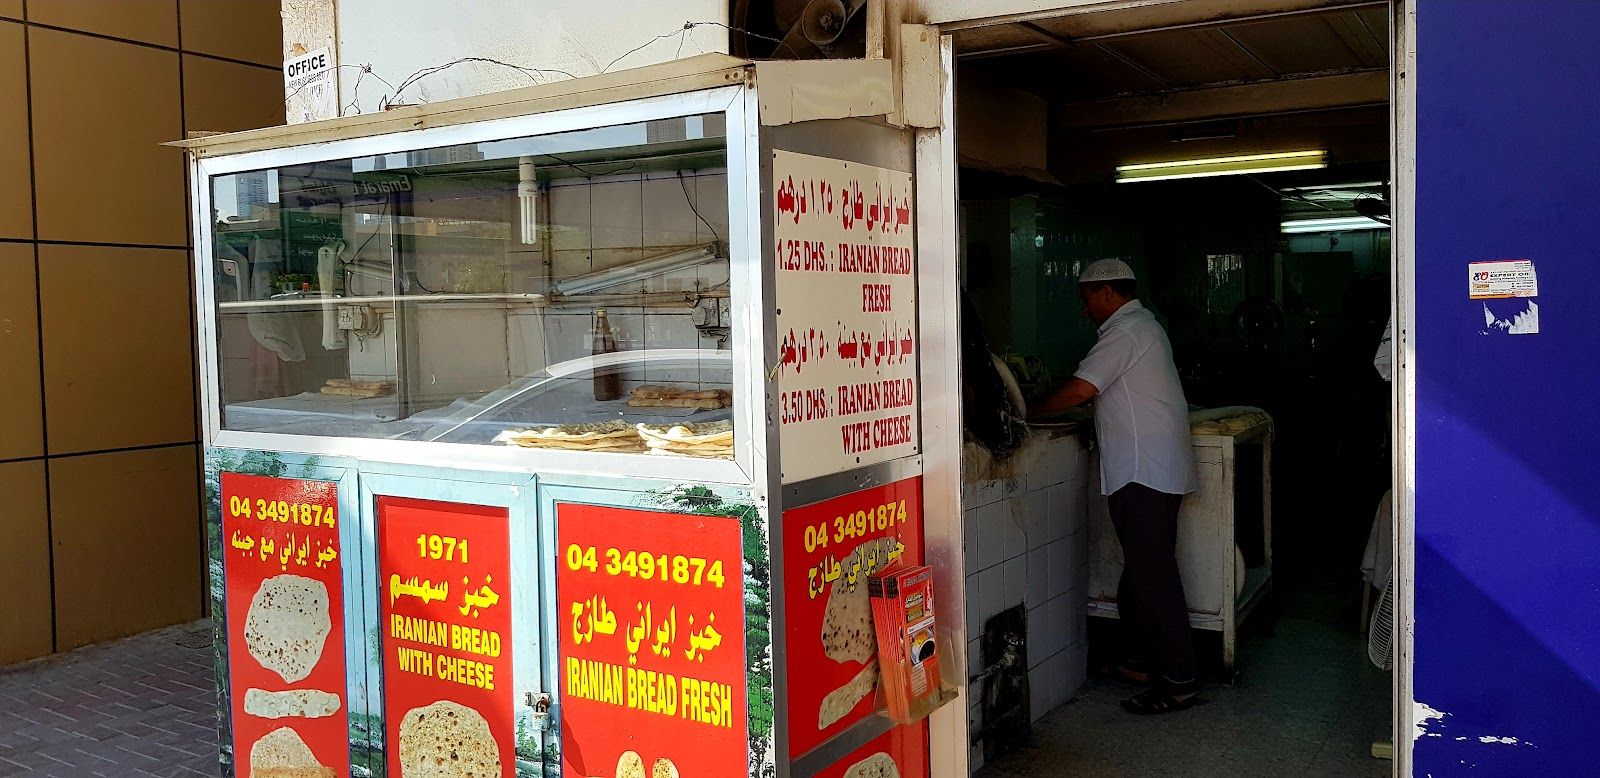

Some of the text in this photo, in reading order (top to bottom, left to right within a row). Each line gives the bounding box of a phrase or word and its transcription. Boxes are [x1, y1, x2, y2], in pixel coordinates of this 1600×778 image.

[288, 54, 326, 77] OFFICE
[842, 177, 863, 230] طازج
[894, 186, 909, 234] خبز
[778, 239, 800, 270] 1.25
[839, 243, 880, 273] IRANIAN
[882, 247, 911, 275] BREAD
[862, 284, 892, 312] FRESH
[861, 331, 871, 368] مع
[782, 390, 803, 424] 3.50
[838, 382, 880, 416] IRANIAN
[883, 378, 913, 409] BREAD
[842, 415, 911, 454] WITH CHEESE
[230, 495, 335, 528] 04 3491874
[804, 499, 907, 552] 04 3491874
[260, 536, 275, 561] مع
[315, 538, 338, 569] خبز
[417, 533, 469, 563] 1971
[566, 544, 725, 588] 04 3491874
[390, 573, 500, 619] خبز سمسم
[808, 555, 842, 600] طازج
[390, 613, 501, 658] IRANIAN BREAD
[571, 593, 617, 645] طازج
[685, 611, 722, 663] خبز
[398, 647, 495, 690] WITH CHEESE
[567, 656, 733, 728] IRANIAN BREAD FRESH
